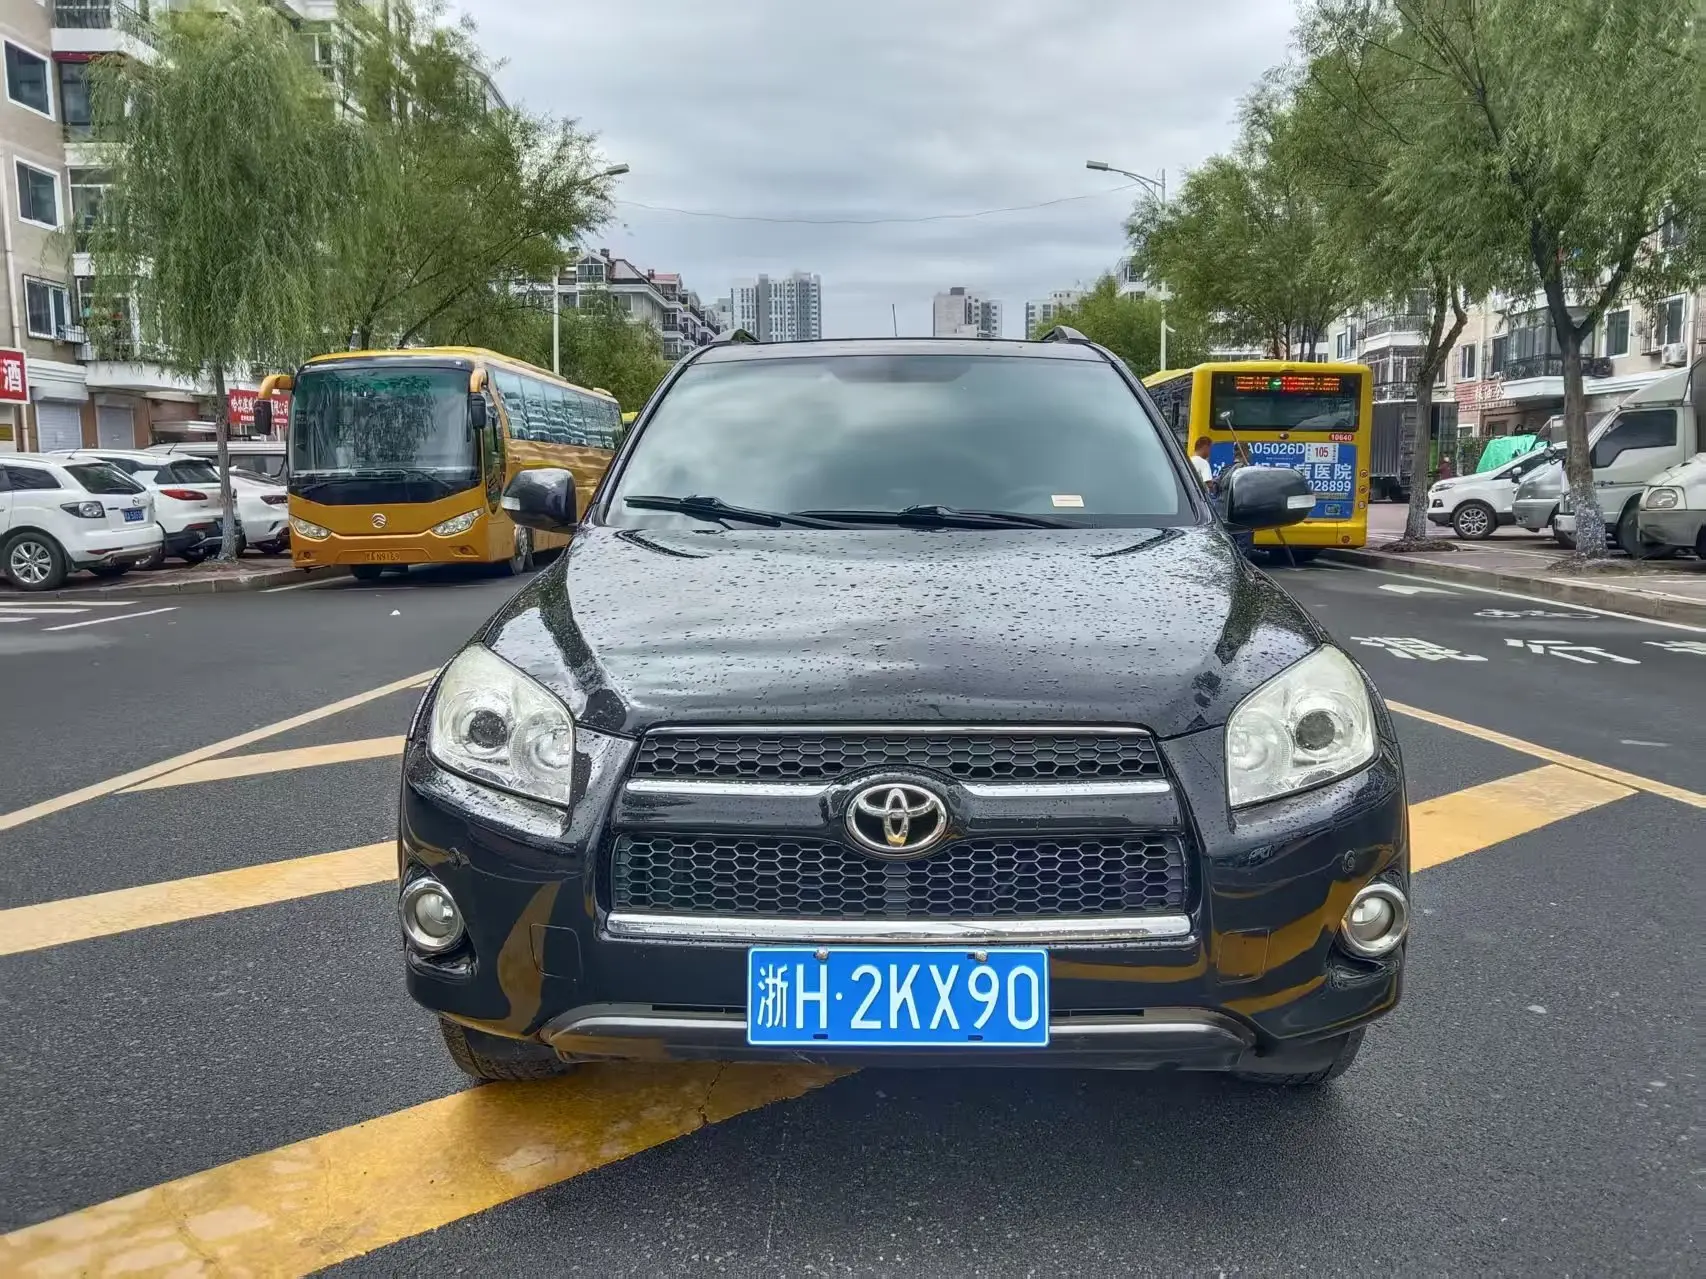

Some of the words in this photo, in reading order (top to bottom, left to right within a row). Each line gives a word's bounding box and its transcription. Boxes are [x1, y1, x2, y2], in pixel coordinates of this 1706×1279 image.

[3, 358, 22, 392] 酒
[1315, 446, 1329, 458] 105
[757, 963, 1040, 1031] 浙H·2KX90
